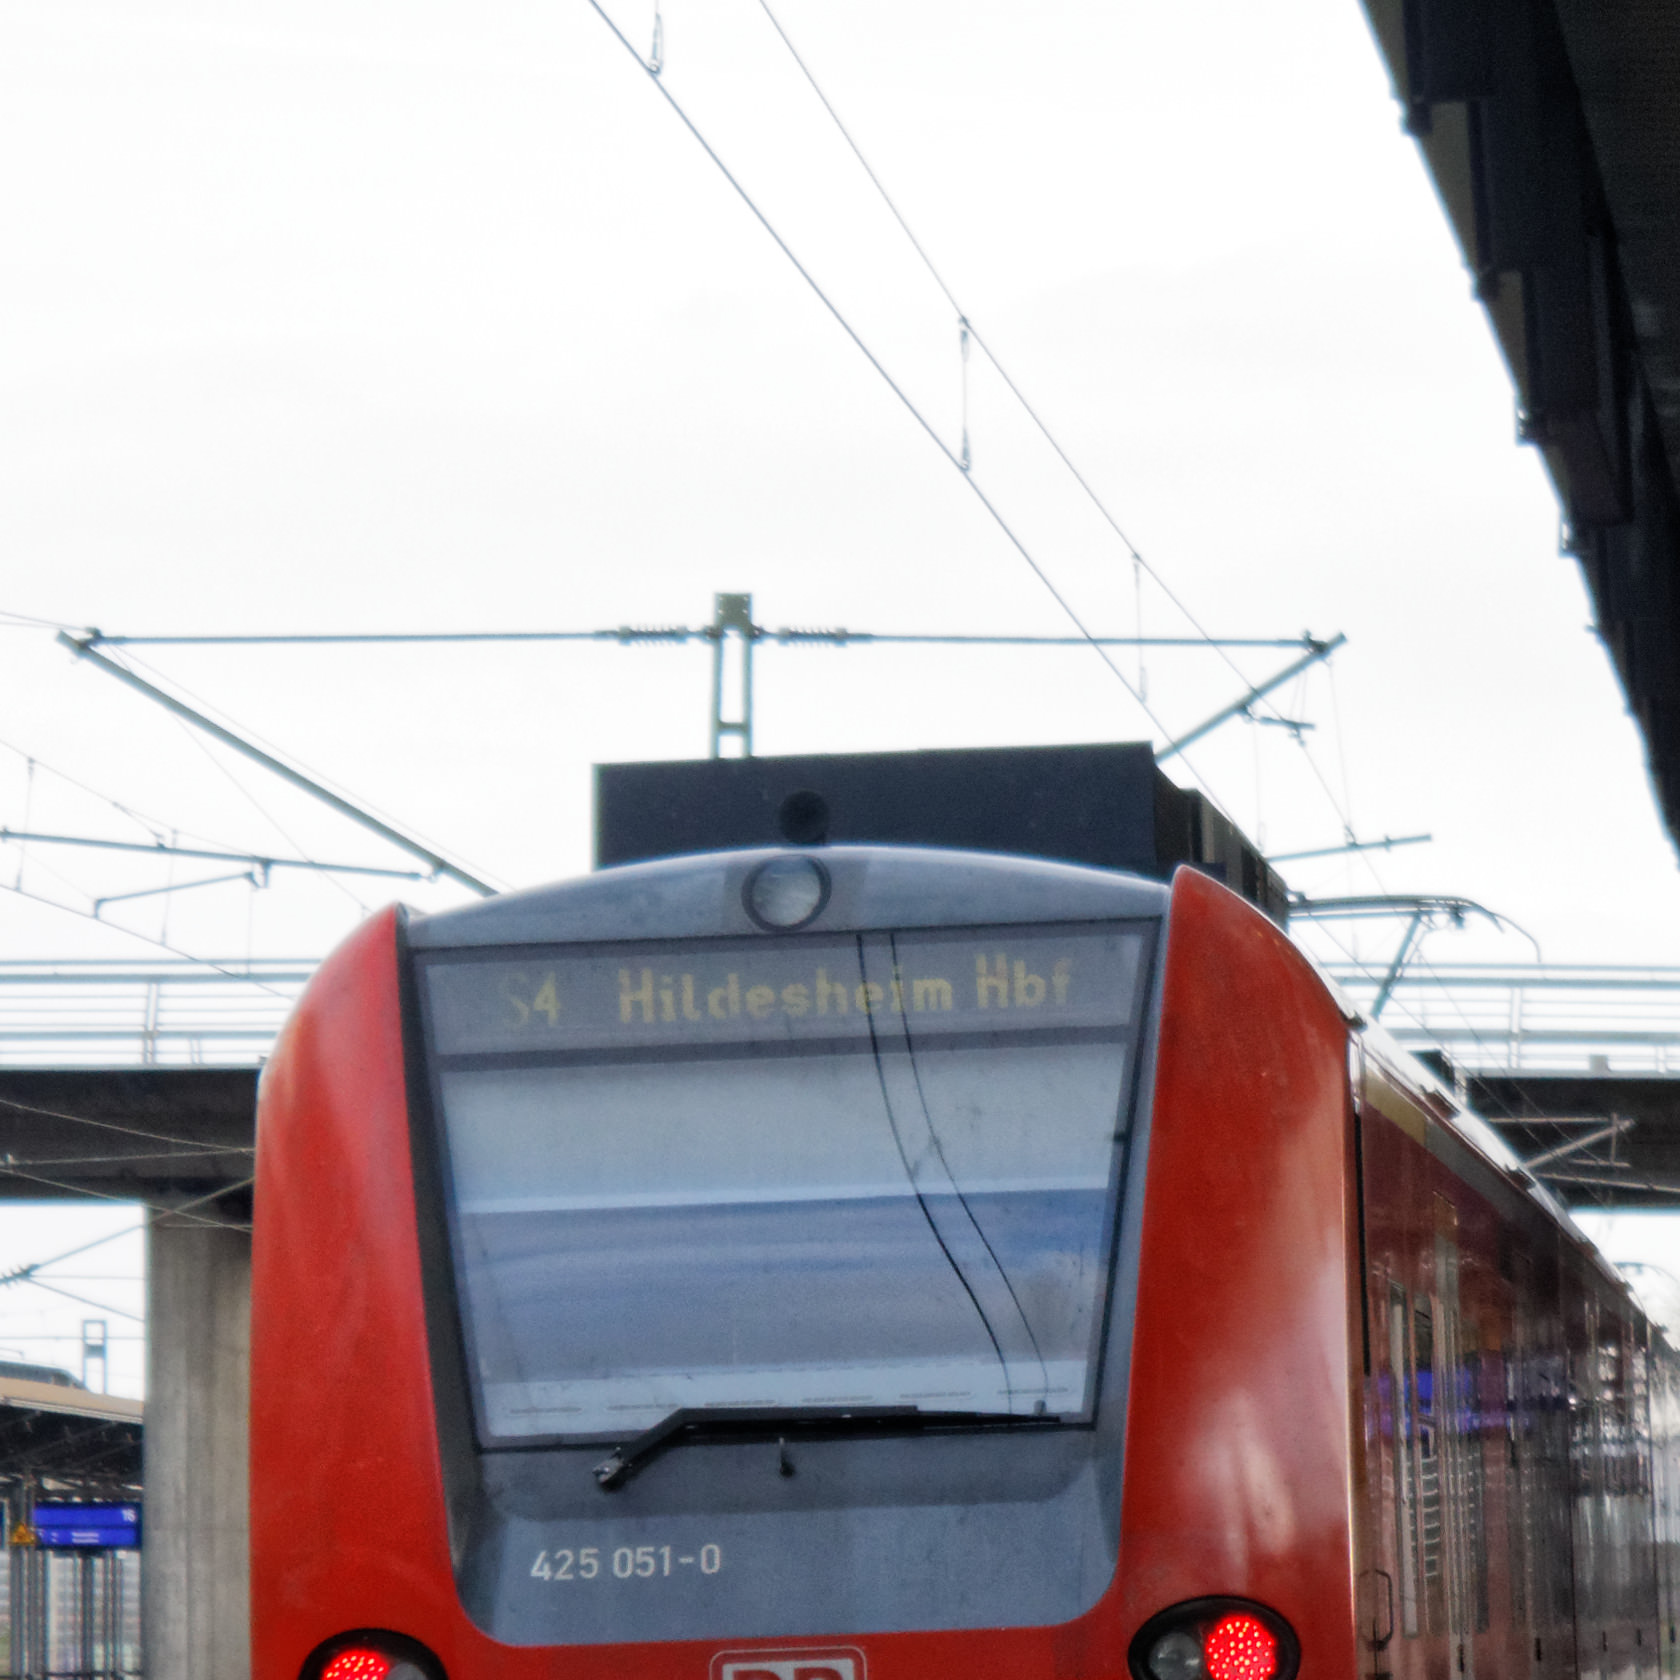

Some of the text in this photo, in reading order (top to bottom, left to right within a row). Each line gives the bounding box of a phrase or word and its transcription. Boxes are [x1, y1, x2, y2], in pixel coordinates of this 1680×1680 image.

[618, 965, 953, 1024] Hildesheim
[975, 953, 1072, 1010] Hbf
[530, 1544, 721, 1581] 425 051-0
